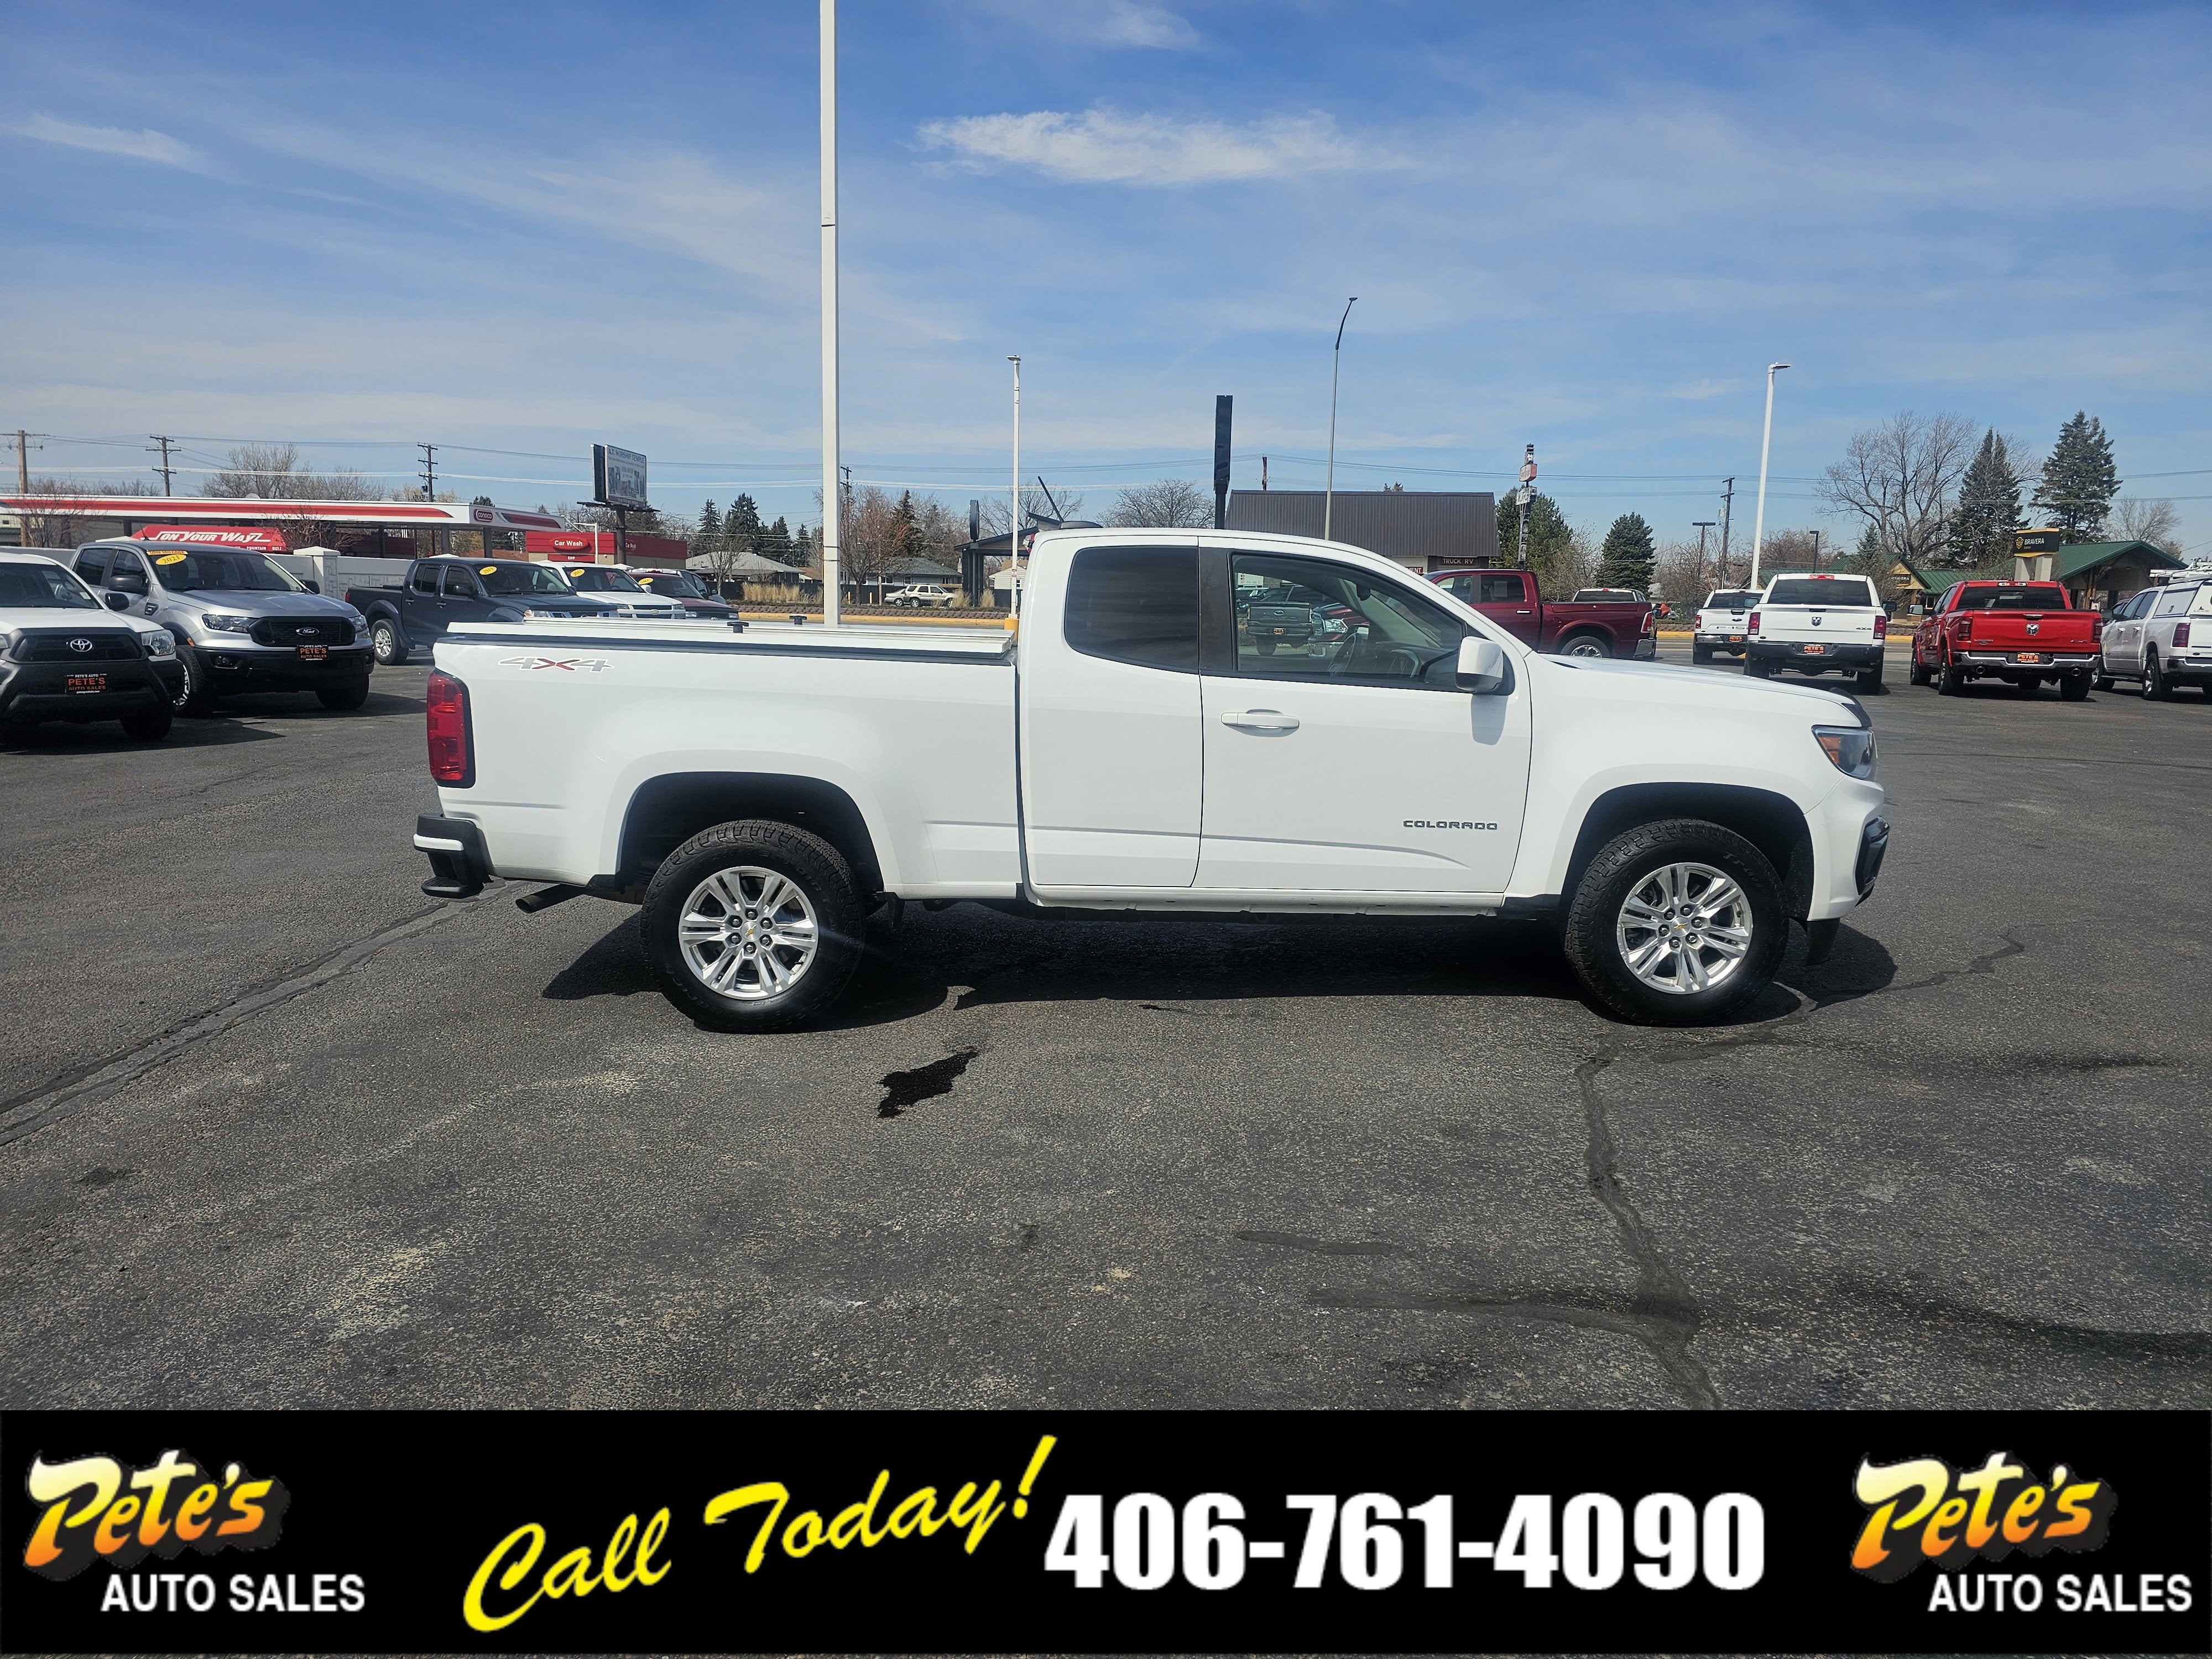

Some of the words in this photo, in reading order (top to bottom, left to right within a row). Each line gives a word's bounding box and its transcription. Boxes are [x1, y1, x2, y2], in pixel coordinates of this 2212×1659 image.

[615, 450, 632, 460] WORSHIP
[632, 454, 645, 464] TEMPLE
[162, 555, 180, 564] 2021
[68, 677, 106, 686] PETE'S
[1403, 820, 1498, 830] COLORADO
